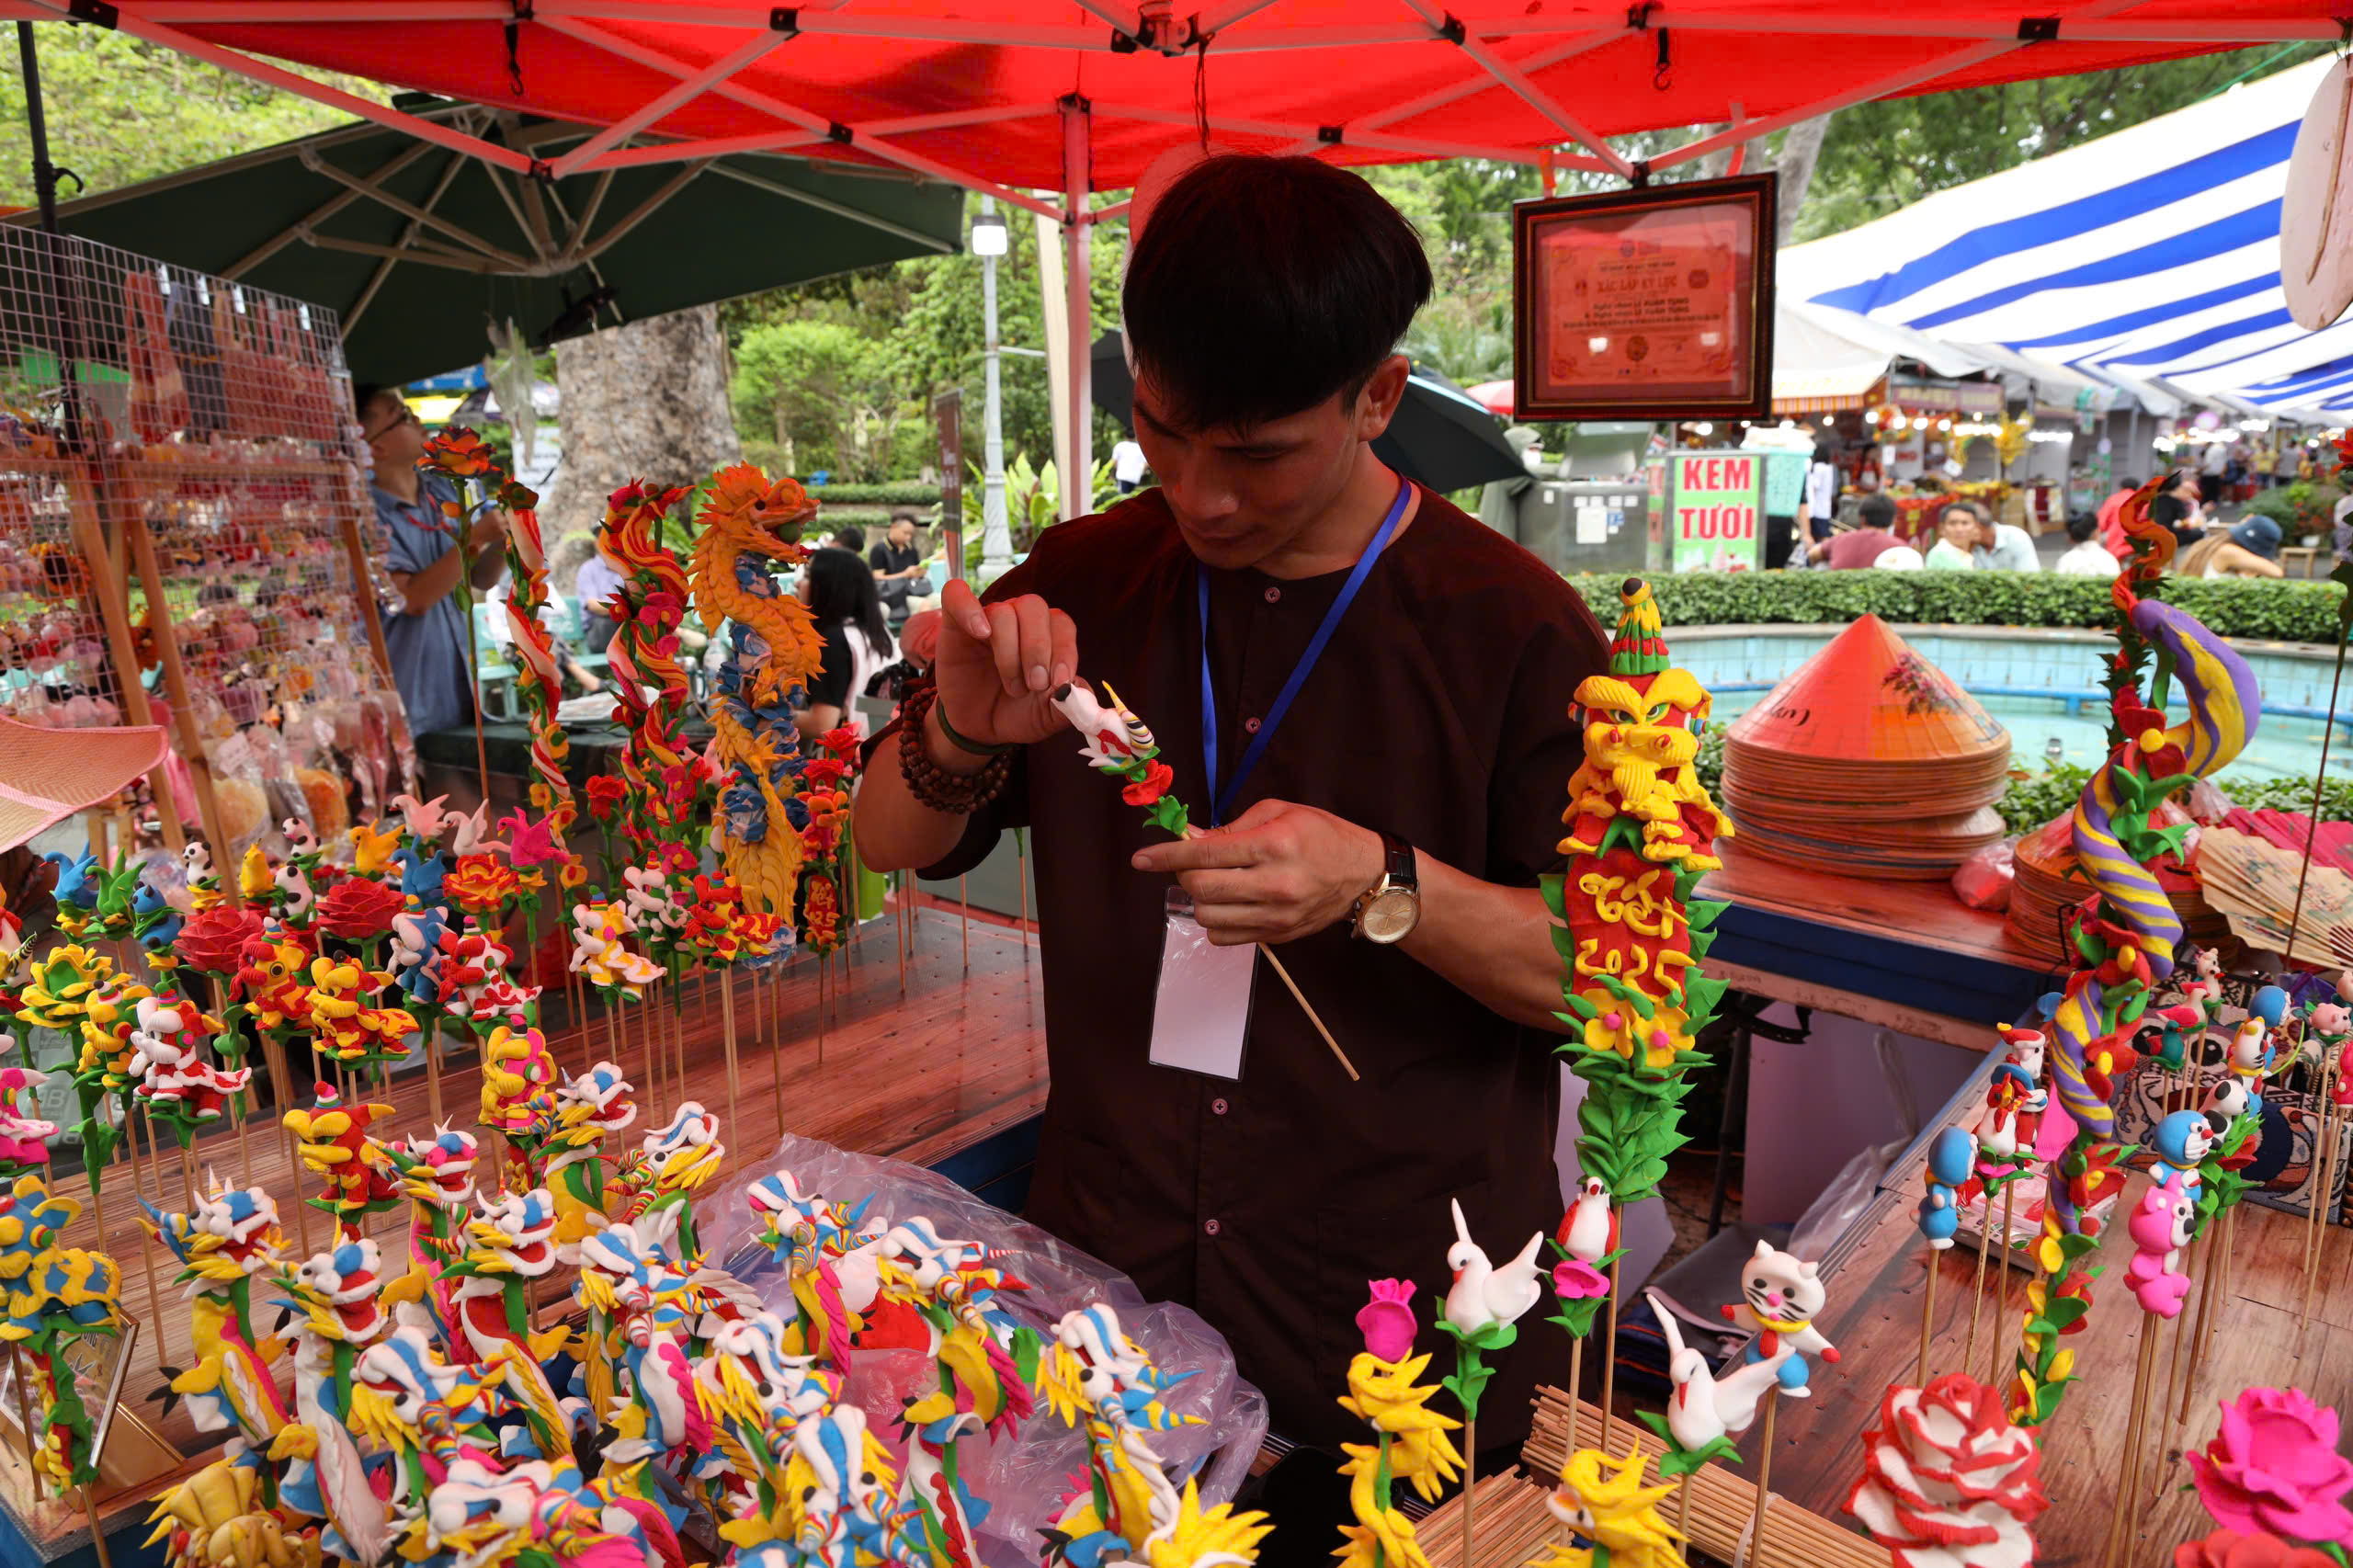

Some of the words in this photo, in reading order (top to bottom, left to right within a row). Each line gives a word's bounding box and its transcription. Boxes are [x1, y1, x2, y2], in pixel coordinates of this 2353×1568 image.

[1684, 459, 1750, 491] KEM
[1678, 502, 1753, 540] TƯƠI
[1574, 937, 1698, 1005] 2025
